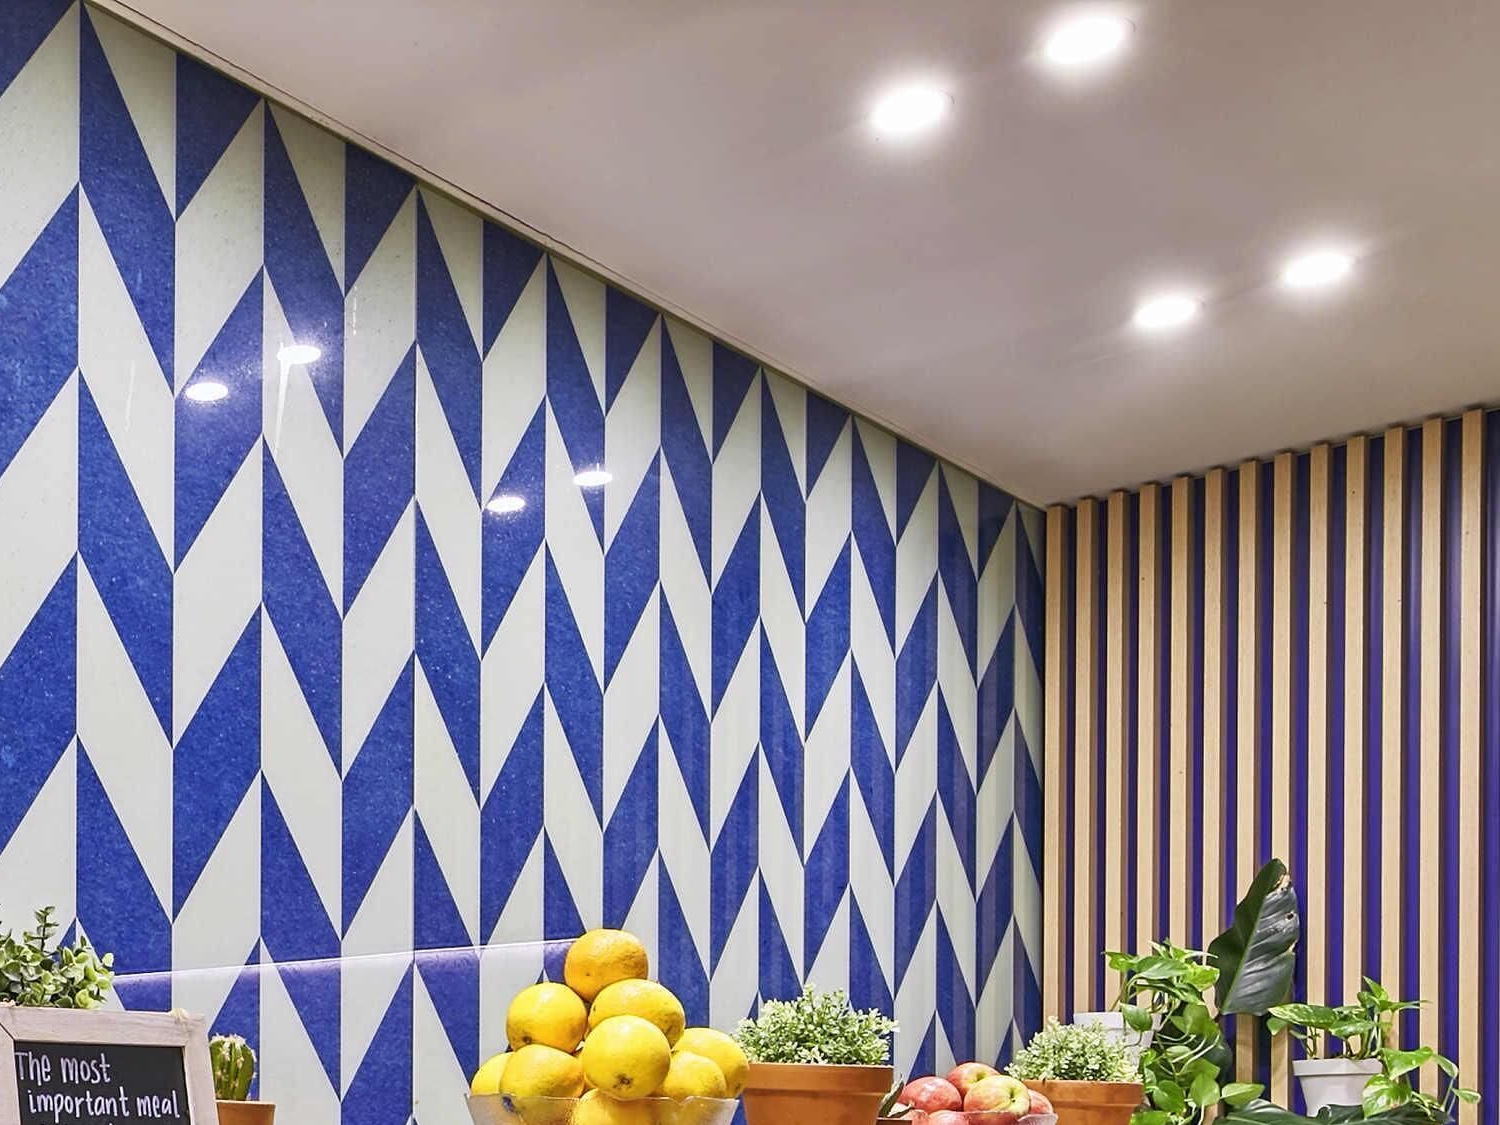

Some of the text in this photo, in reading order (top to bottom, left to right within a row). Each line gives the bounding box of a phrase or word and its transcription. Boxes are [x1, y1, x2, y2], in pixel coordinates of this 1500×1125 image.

[14, 1051, 111, 1086] The most
[27, 1086, 181, 1123] important meal
